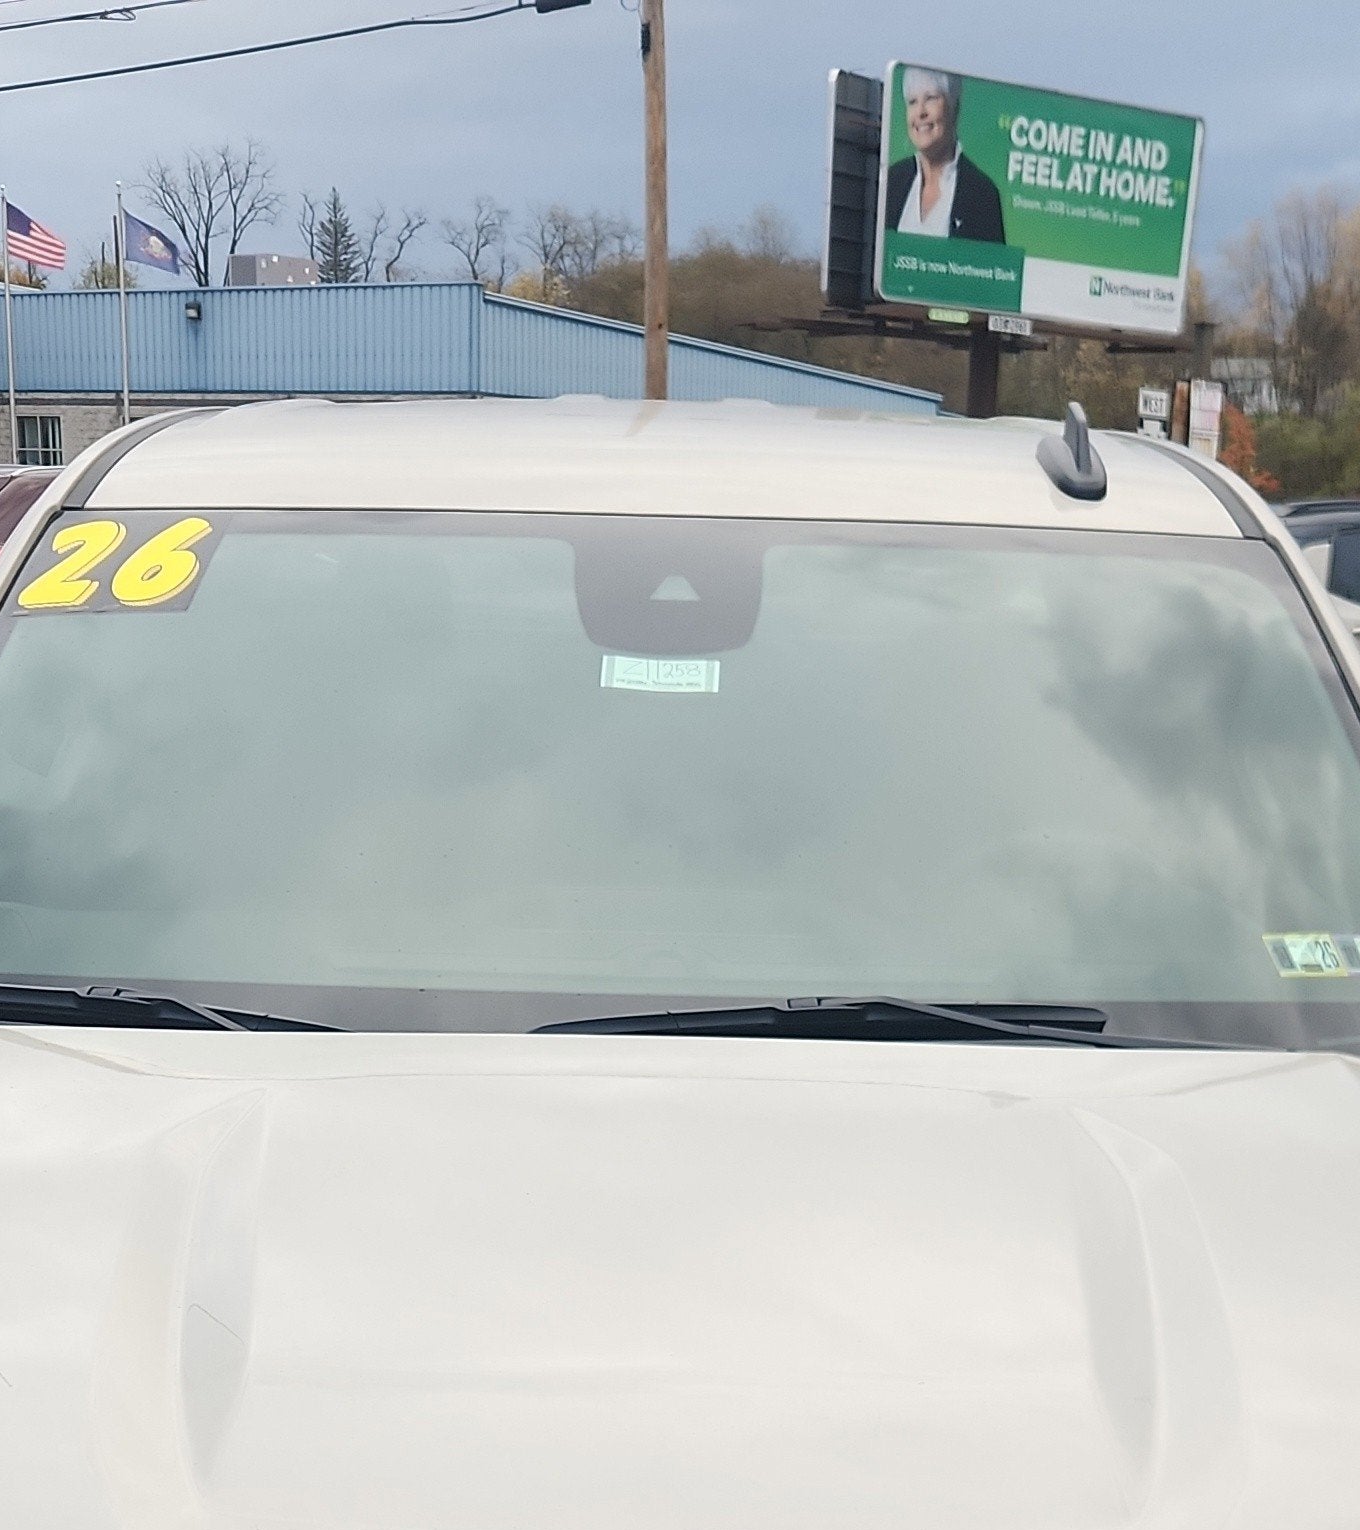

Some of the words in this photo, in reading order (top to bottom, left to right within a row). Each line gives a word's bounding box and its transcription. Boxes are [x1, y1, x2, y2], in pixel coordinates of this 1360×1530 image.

[1088, 129, 1115, 162] IN
[1116, 135, 1170, 171] AND
[1007, 151, 1064, 190] FEEL
[1065, 160, 1099, 194] AT
[948, 260, 993, 280] Northwest
[1103, 280, 1151, 299] Northwest
[18, 517, 213, 609] 26
[1315, 940, 1340, 968] 26
